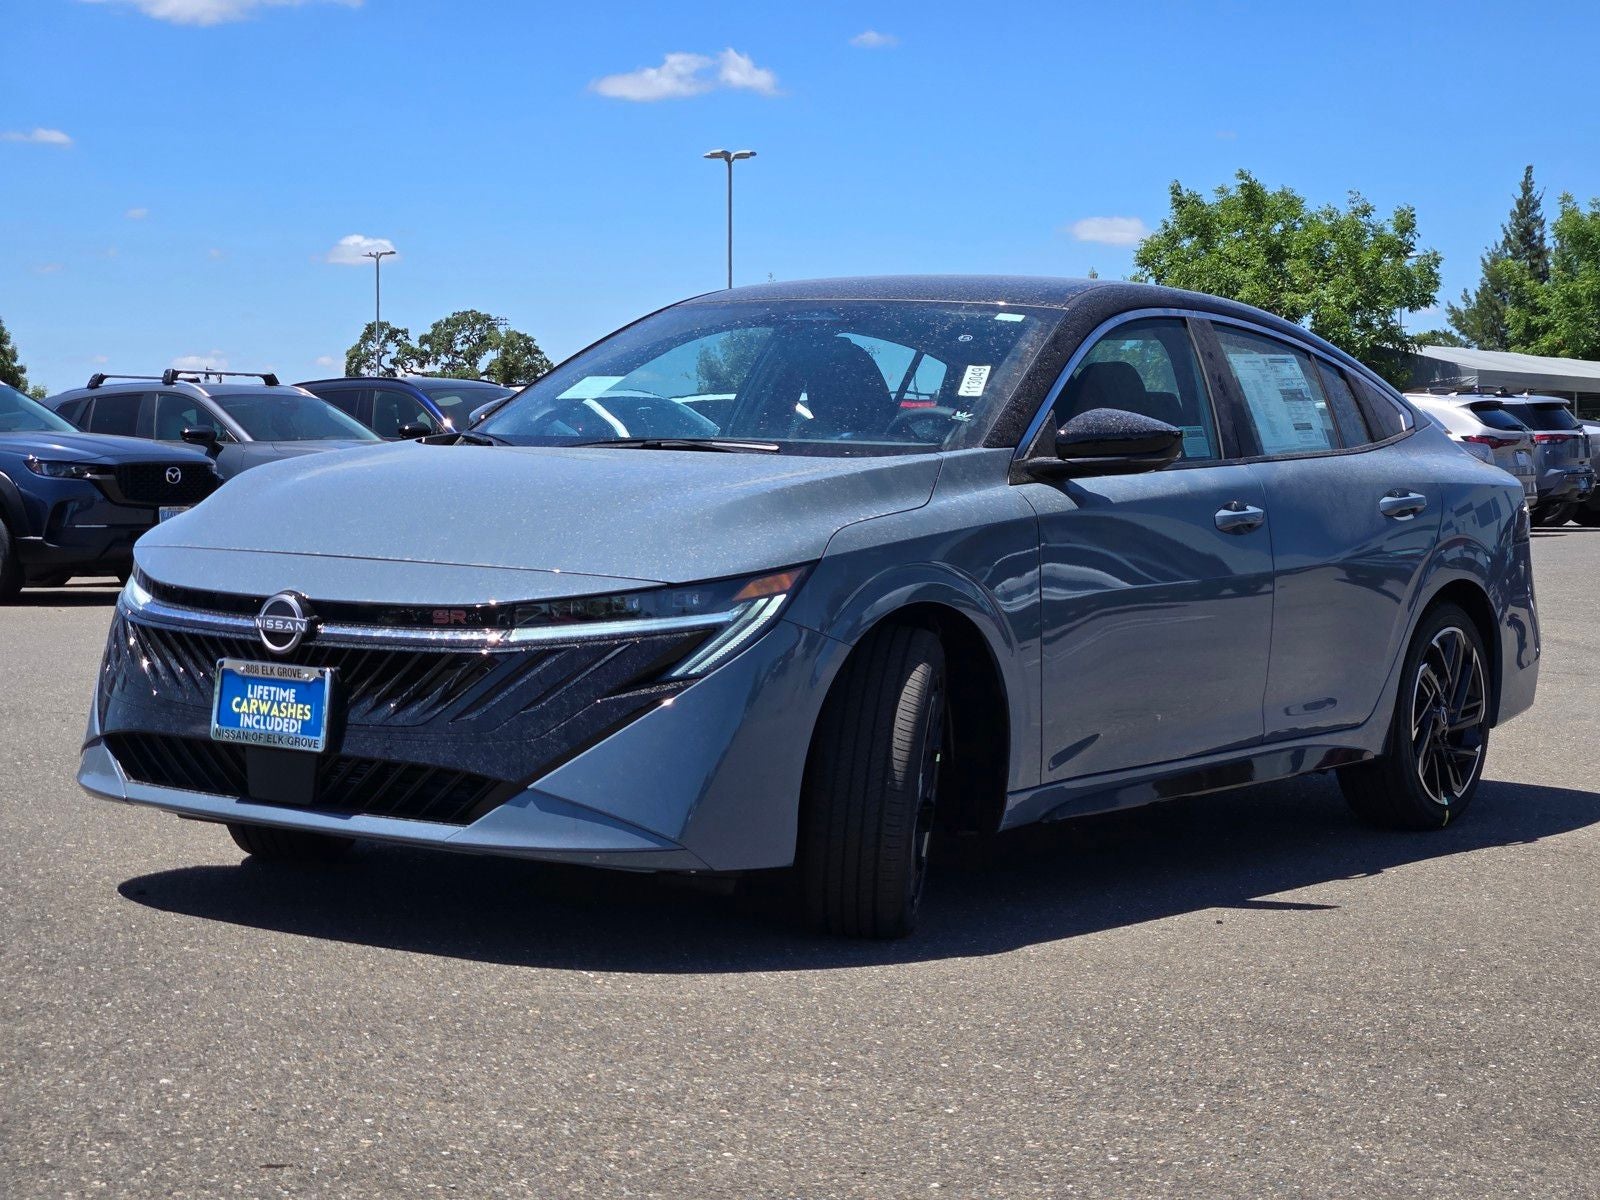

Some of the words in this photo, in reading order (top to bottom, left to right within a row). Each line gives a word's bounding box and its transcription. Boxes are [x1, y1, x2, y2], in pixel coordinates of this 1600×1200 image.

[255, 618, 306, 632] NISSAN
[432, 609, 467, 624] SR
[261, 665, 275, 676] ELK
[277, 667, 302, 679] GROVE
[247, 684, 297, 703] LIFETIME
[231, 697, 312, 721] CARWASHES
[239, 714, 302, 734] INCLUDED!
[214, 728, 250, 741] NISSAN
[251, 732, 263, 742] OF
[266, 734, 284, 745] ELK
[287, 736, 319, 749] GROVE
